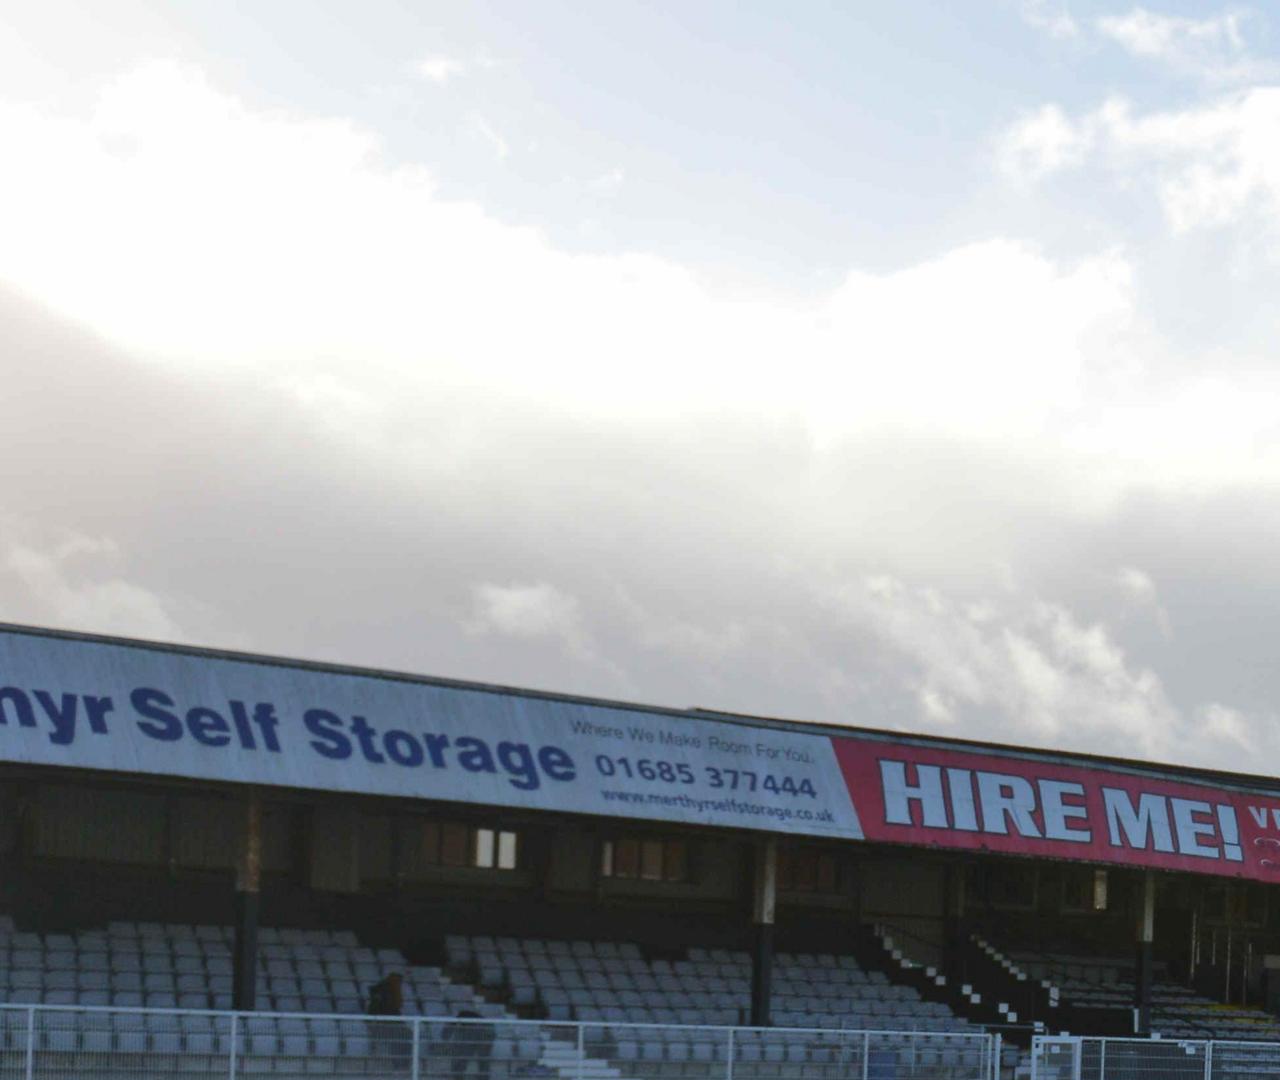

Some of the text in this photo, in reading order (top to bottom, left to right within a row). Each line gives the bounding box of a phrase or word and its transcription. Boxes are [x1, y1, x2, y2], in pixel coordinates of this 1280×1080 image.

[130, 687, 281, 753] Self
[303, 708, 576, 791] Storage
[571, 720, 624, 739] Where
[627, 727, 654, 743] We
[660, 731, 700, 749] Make
[708, 735, 752, 754] Room
[756, 743, 779, 760] For
[595, 754, 818, 799] 01685 377444
[600, 789, 836, 823] www.merthyrselfstorage.co.uk
[879, 758, 1244, 862] HIRE ME!
